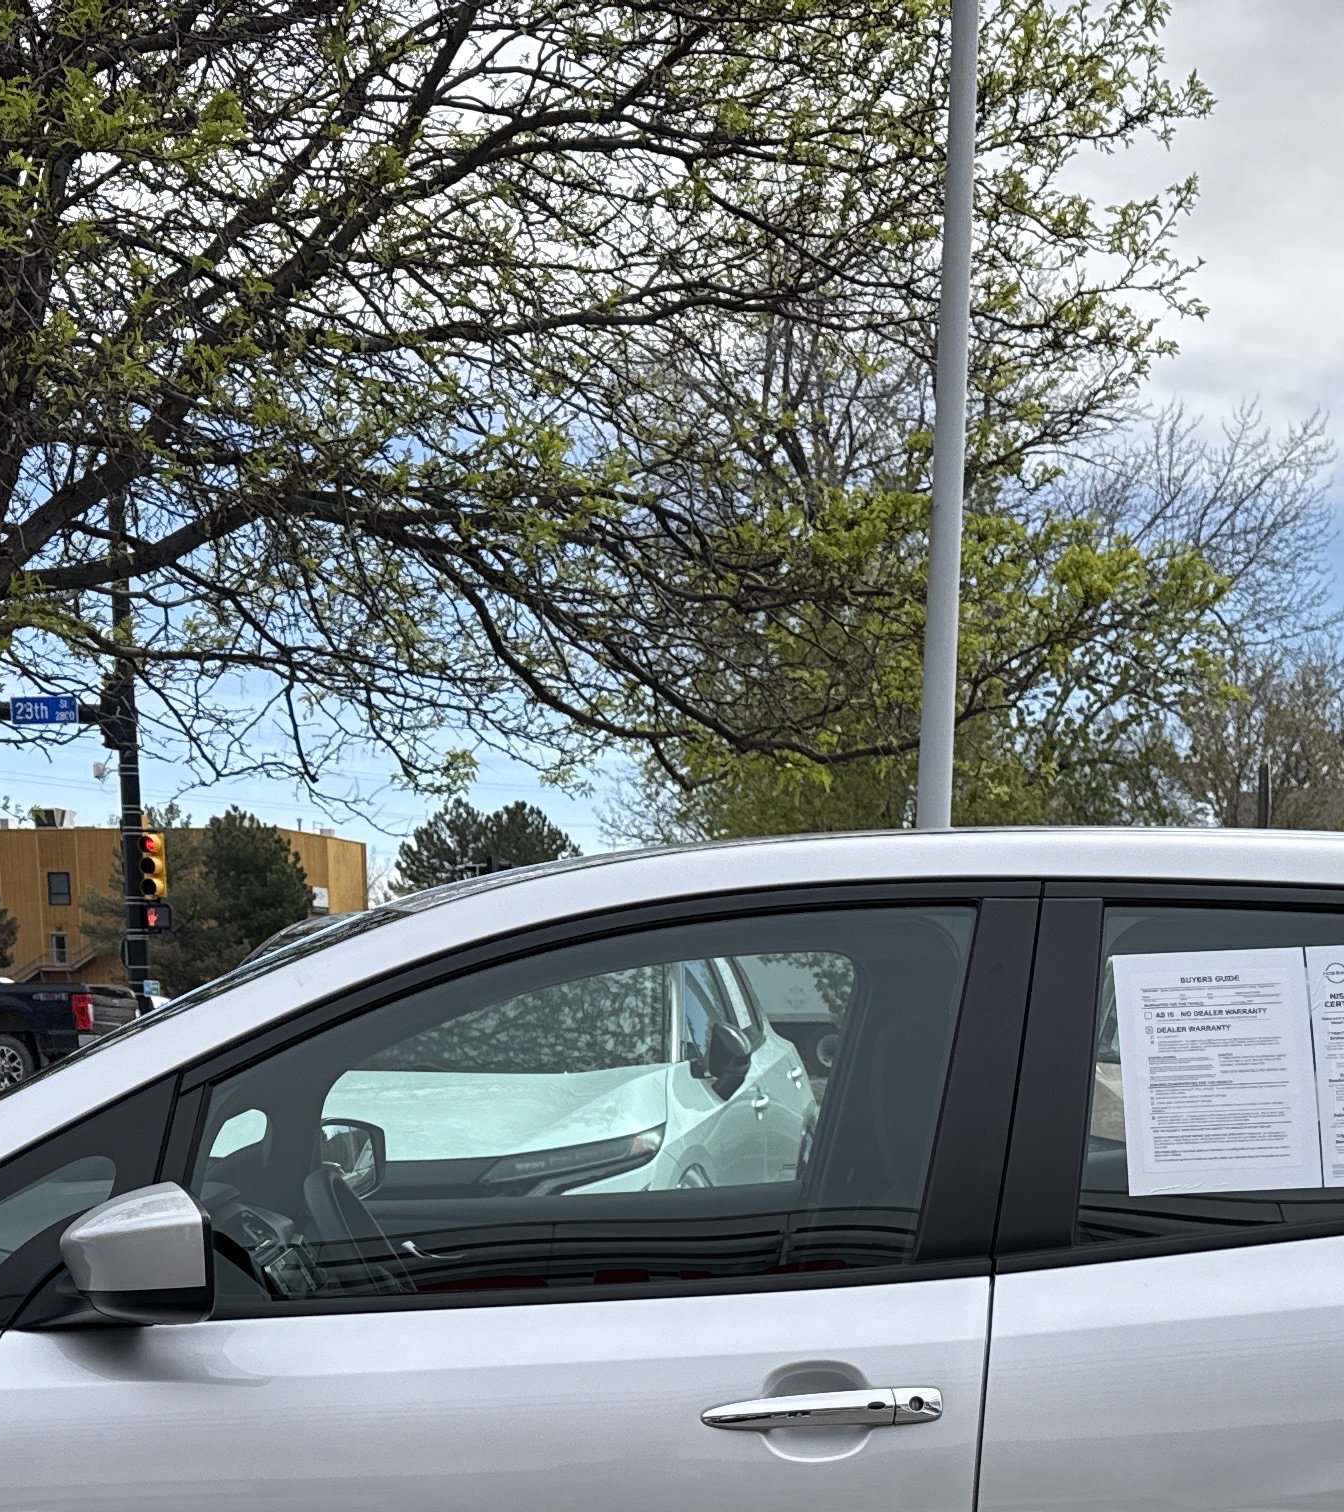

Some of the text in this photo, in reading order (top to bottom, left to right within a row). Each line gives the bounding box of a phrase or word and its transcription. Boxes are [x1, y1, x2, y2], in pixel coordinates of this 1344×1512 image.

[1180, 974, 1240, 984] BUYERS GUIDE
[1193, 1009, 1224, 1017] DEALER
[1225, 1007, 1268, 1015] WARRANTY
[1188, 1024, 1232, 1032] WARRANTY
